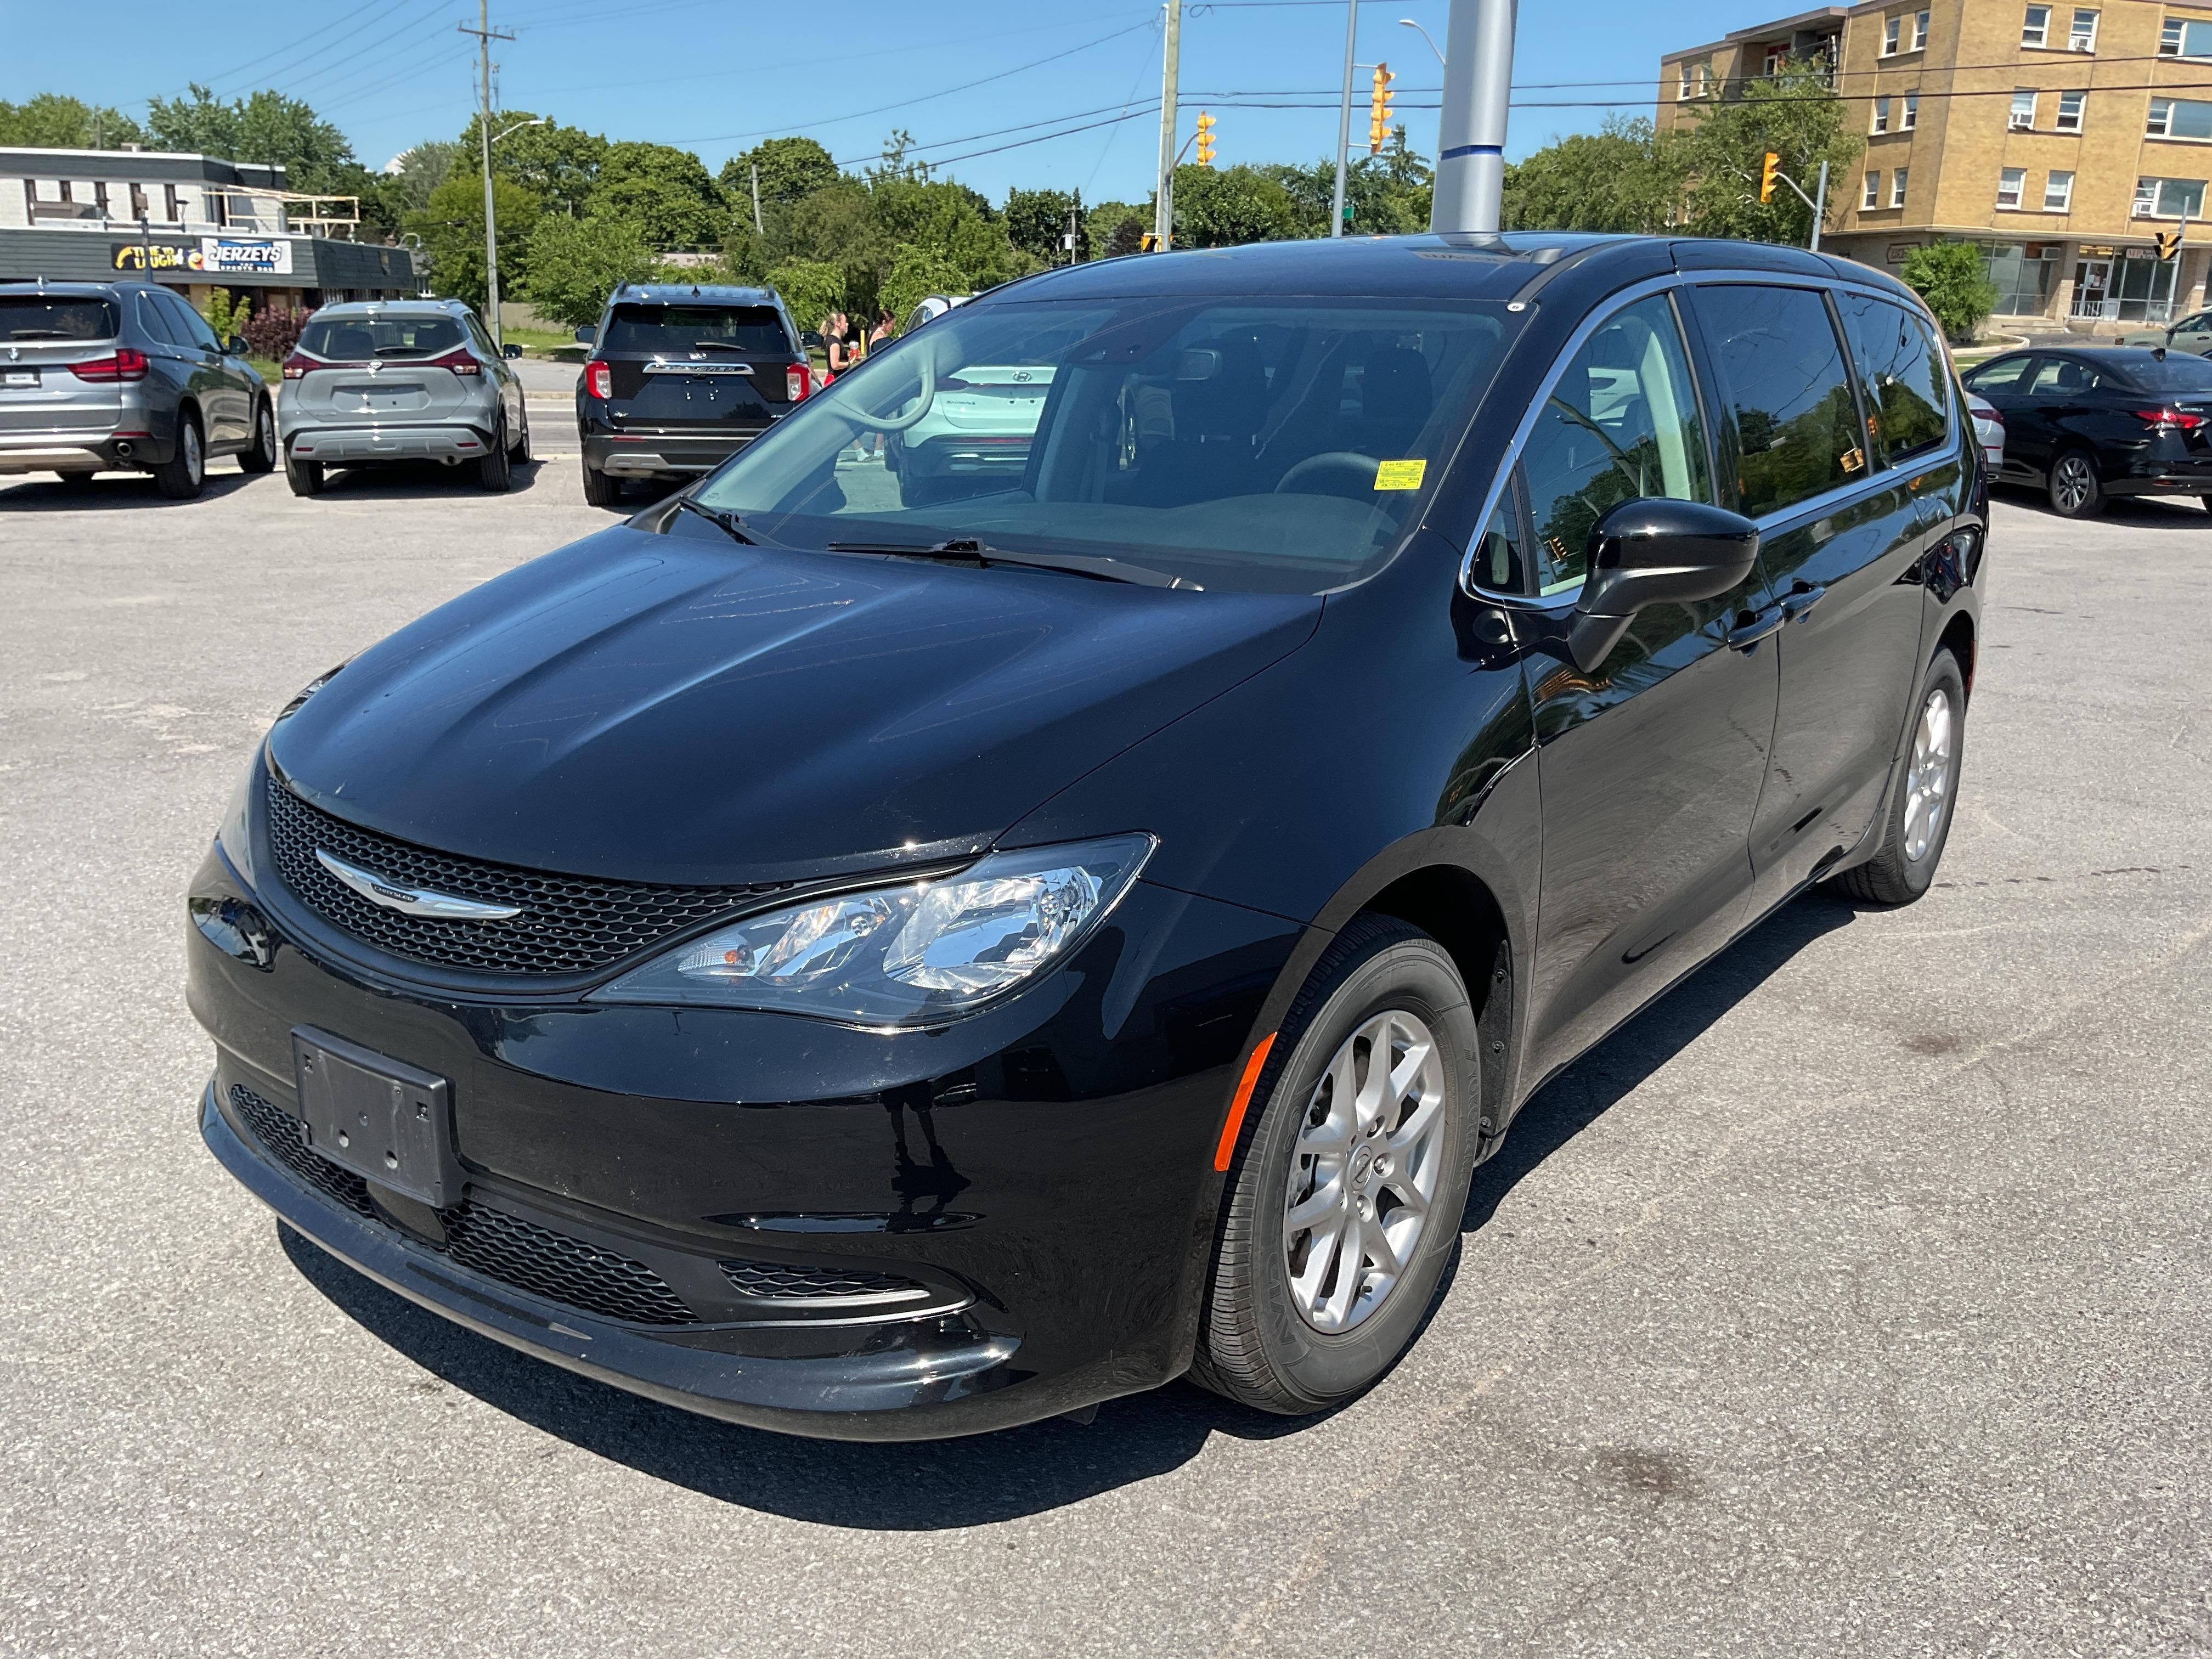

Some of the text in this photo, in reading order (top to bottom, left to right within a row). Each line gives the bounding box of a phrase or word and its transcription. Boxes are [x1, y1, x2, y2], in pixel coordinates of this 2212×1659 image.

[210, 246, 281, 262] JERZEYS
[374, 886, 414, 901] CHRYSLER
[1457, 1068, 1478, 1190] YOKOHAMA
